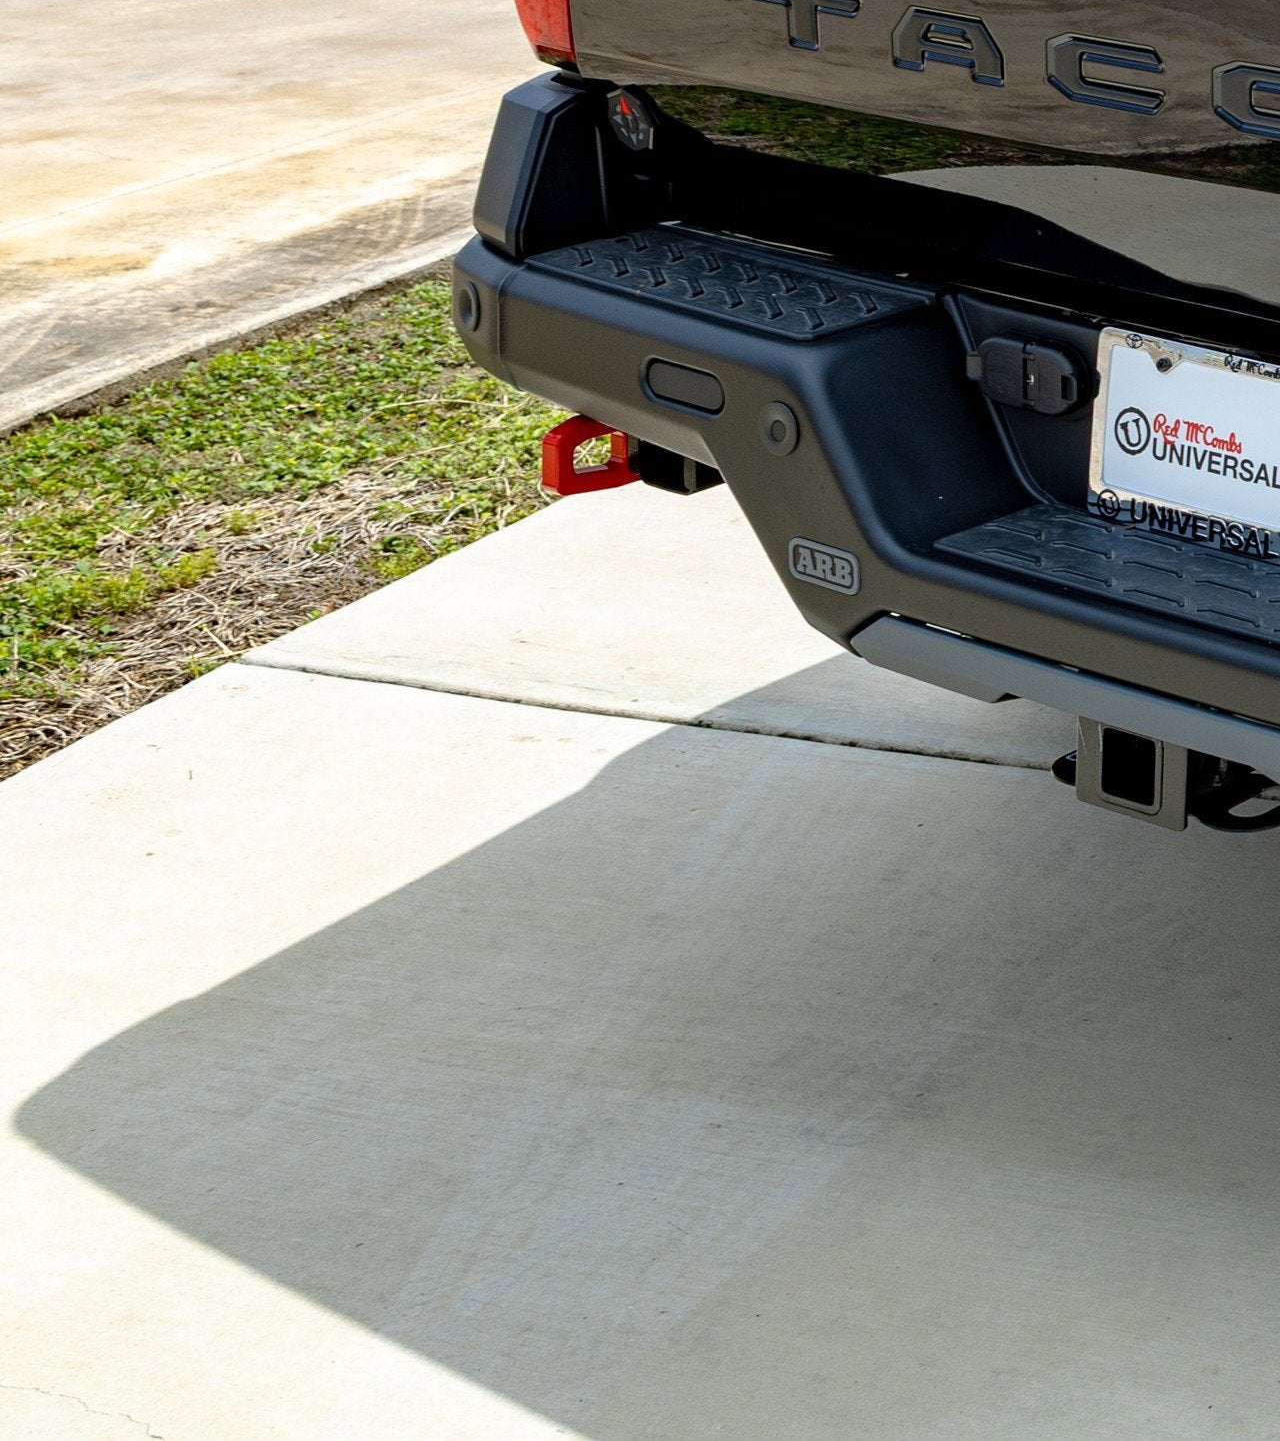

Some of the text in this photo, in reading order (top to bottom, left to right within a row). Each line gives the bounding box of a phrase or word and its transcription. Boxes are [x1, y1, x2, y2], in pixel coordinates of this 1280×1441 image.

[1224, 354, 1243, 373] Red
[1153, 413, 1243, 455] Red McCombs
[796, 546, 854, 587] ARB
